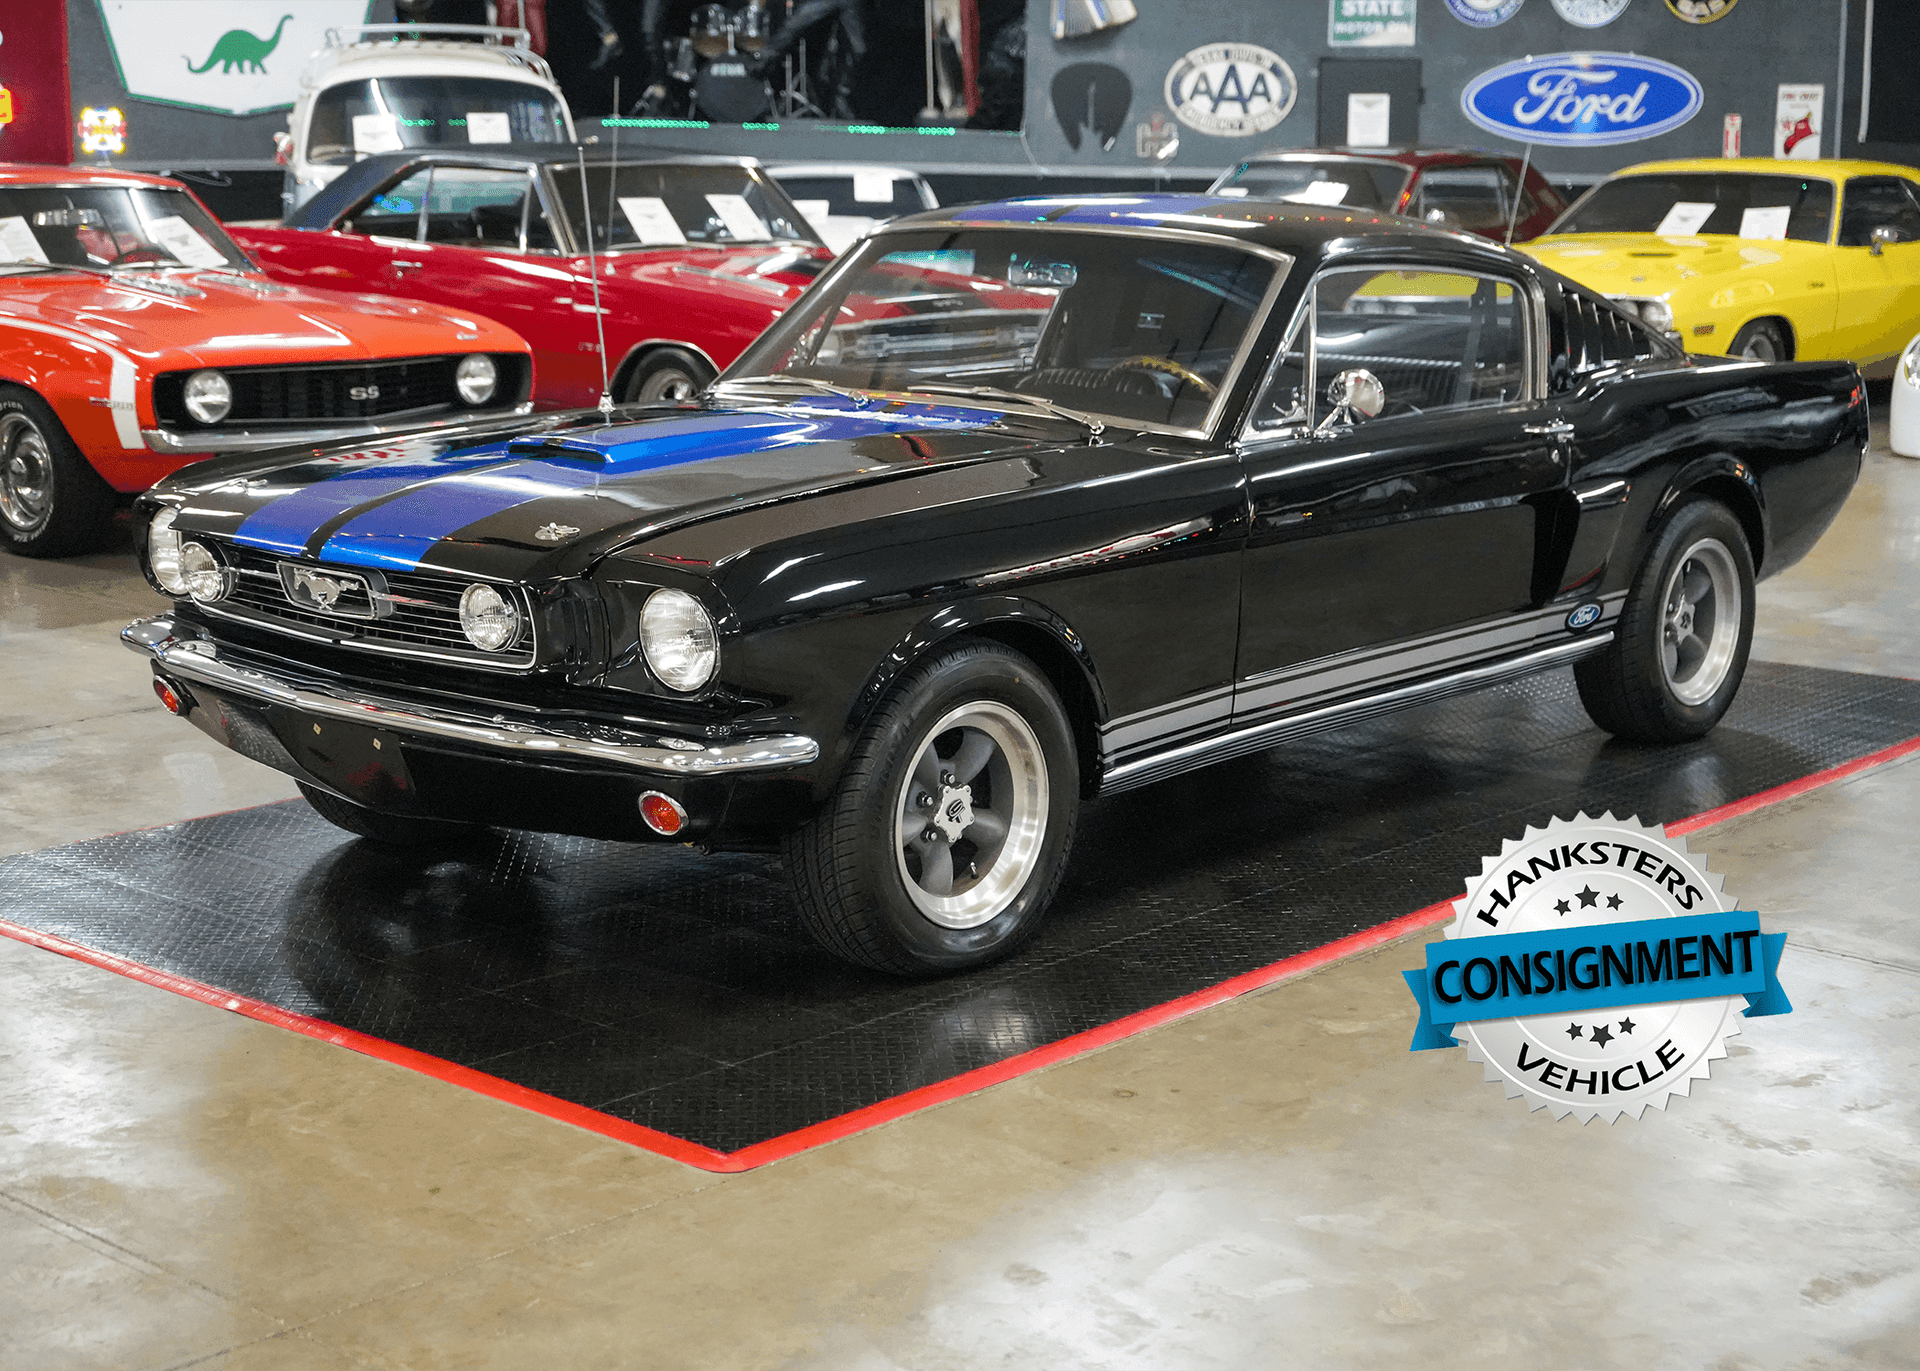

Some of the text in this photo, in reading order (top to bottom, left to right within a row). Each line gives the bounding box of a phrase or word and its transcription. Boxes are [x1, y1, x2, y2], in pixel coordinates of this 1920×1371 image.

[1341, 0, 1405, 17] STATE
[1189, 63, 1272, 114] AAA
[1513, 68, 1650, 124] Ford
[350, 385, 380, 400] SS
